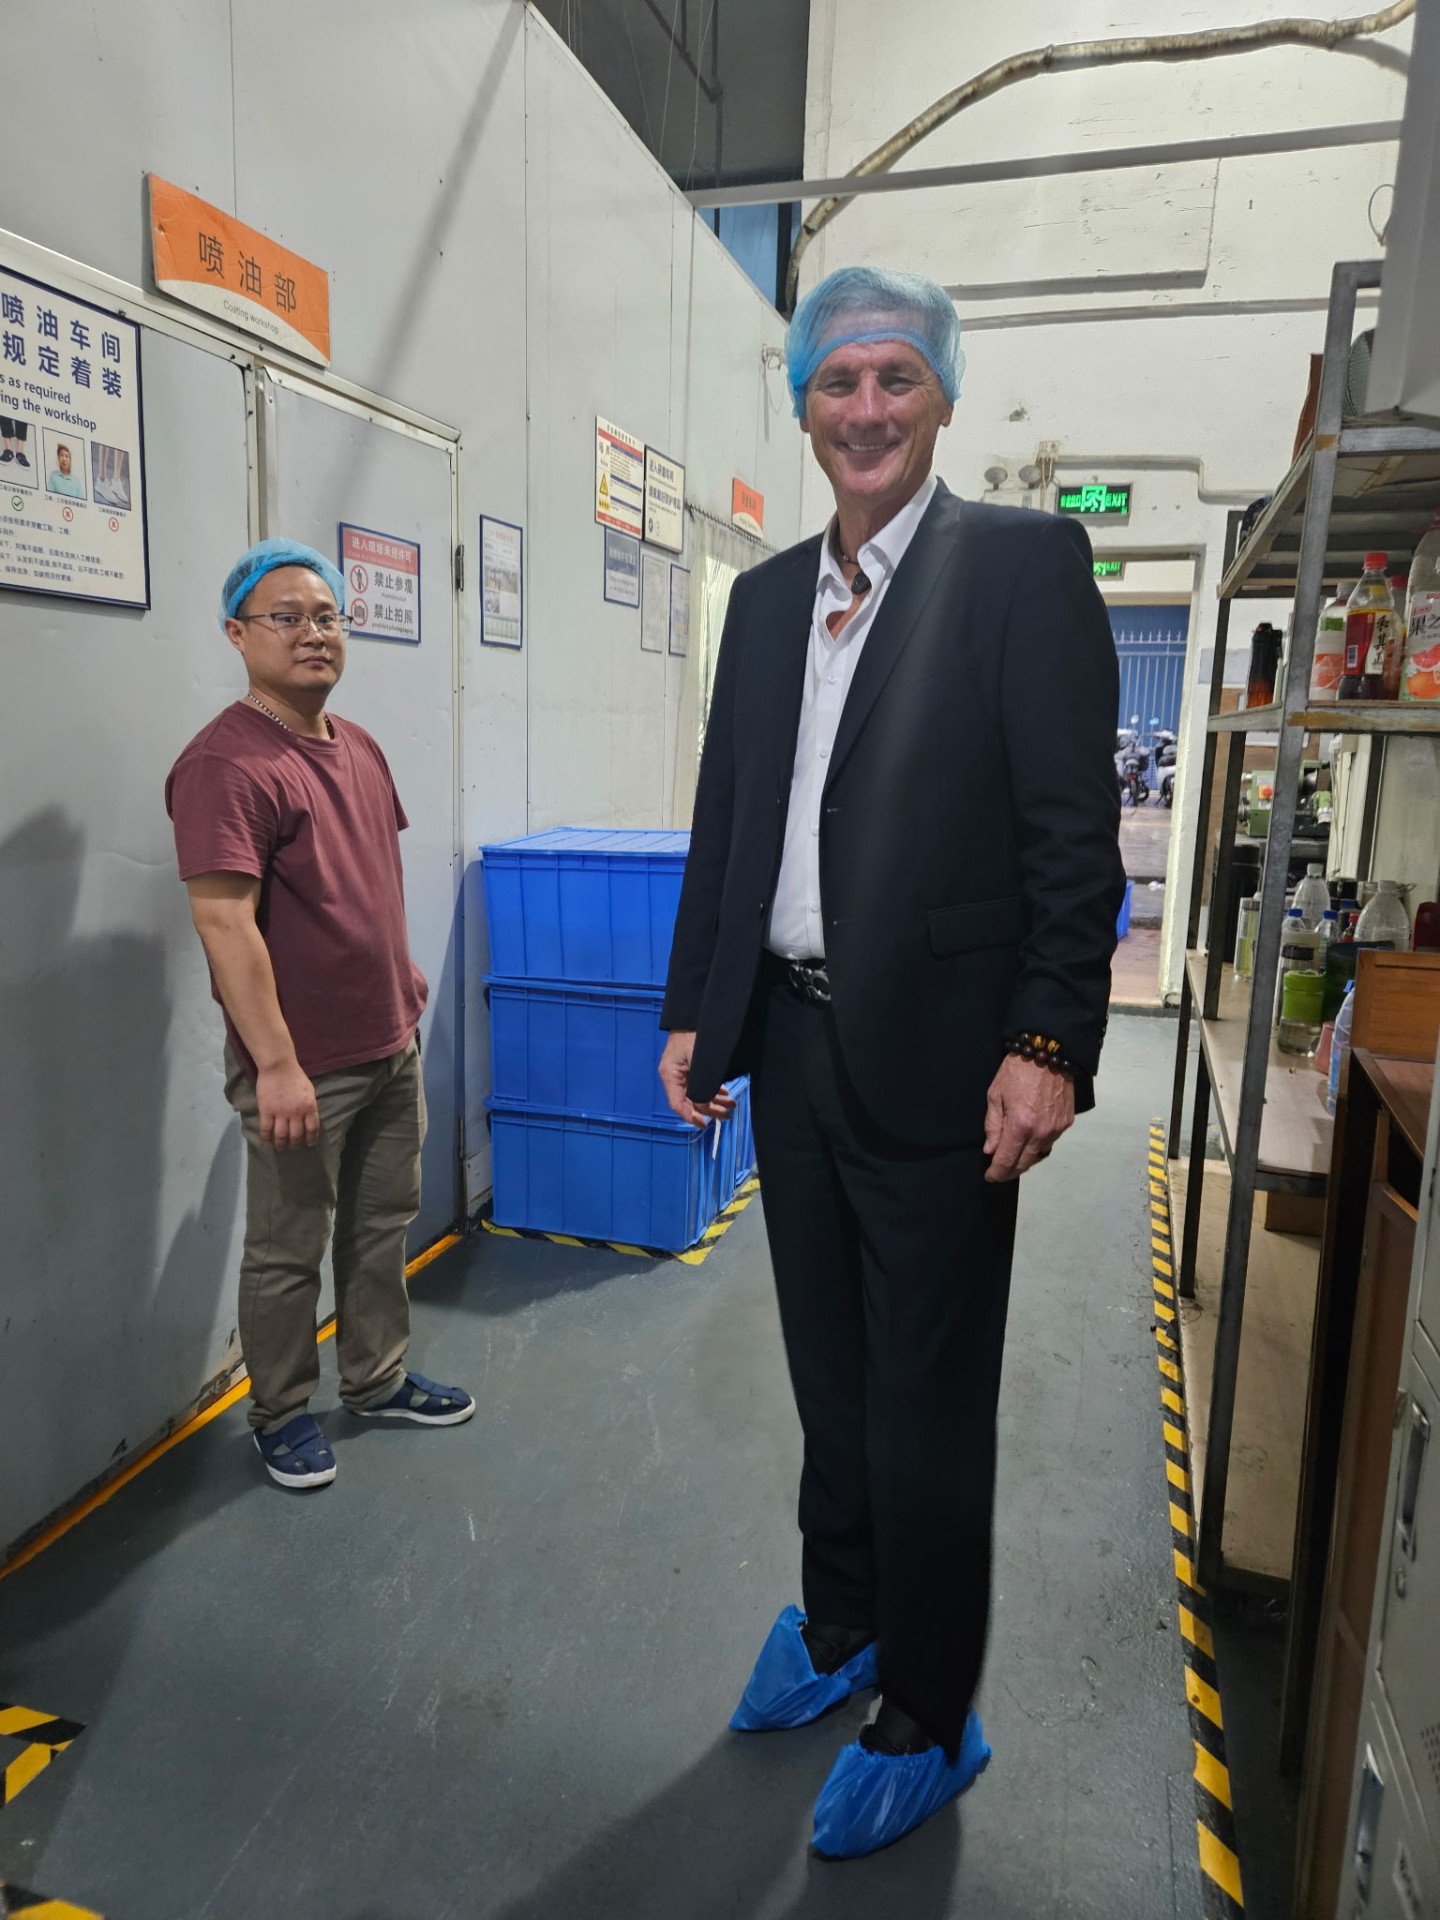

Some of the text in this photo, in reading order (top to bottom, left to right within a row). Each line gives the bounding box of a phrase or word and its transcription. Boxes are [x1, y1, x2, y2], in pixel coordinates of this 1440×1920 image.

[198, 232, 297, 313] 喷油部
[1, 292, 121, 364] 喷油车间
[223, 300, 279, 335] Coating workshop
[2, 331, 122, 399] 规定着装
[8, 376, 21, 389] as
[24, 382, 71, 405] required
[22, 398, 41, 414] the
[44, 406, 97, 433] workshop
[1106, 493, 1127, 507] EXIT
[374, 571, 413, 594] 禁止参观
[374, 603, 413, 624] 禁止拍照
